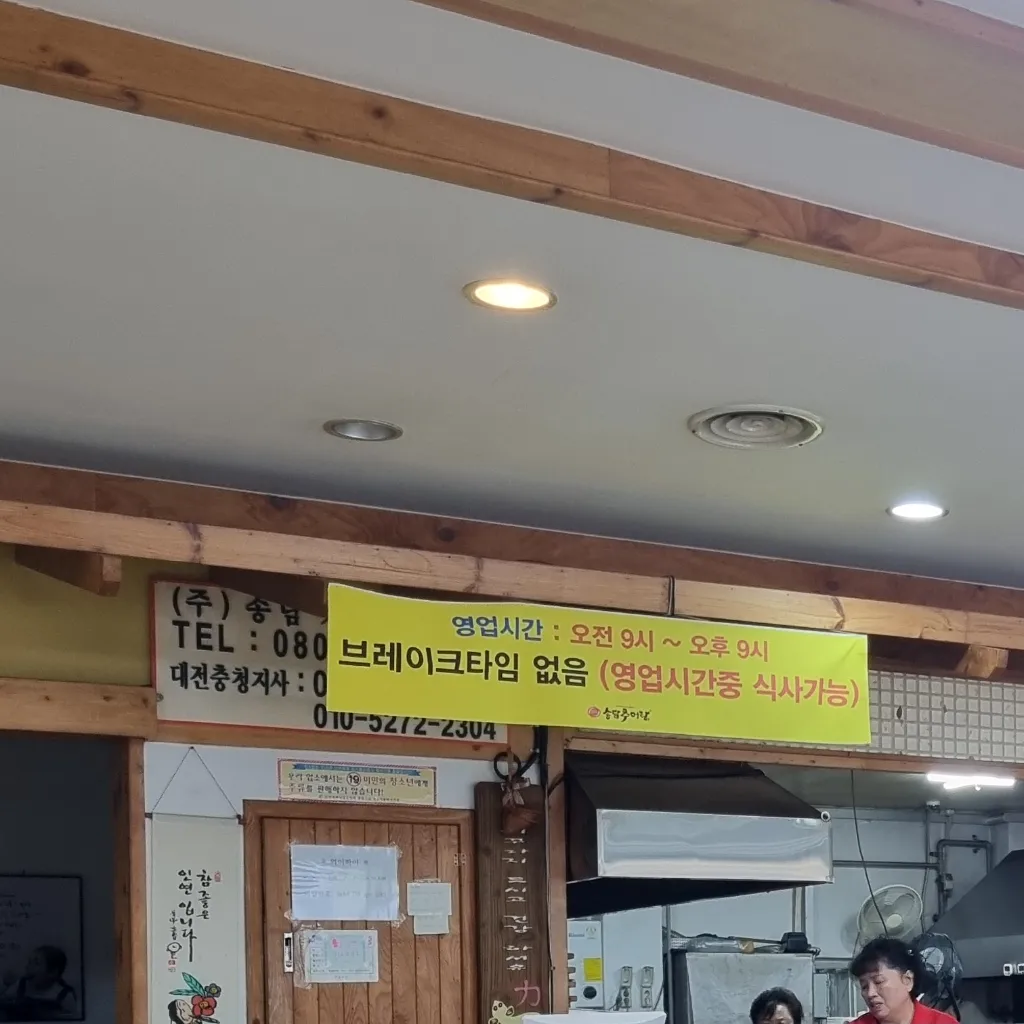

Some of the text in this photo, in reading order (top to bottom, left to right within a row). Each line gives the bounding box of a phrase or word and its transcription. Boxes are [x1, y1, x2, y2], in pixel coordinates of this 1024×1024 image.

[172, 585, 230, 622] (주)
[172, 620, 235, 654] TEL
[451, 615, 544, 641] 영업시간
[569, 622, 614, 650] 오전
[621, 629, 655, 653] 9시
[688, 634, 731, 659] 오후
[736, 638, 770, 662] 9시
[170, 662, 290, 697] 대전충청지사
[338, 637, 861, 709] 브레이크타임 없음 (영업시간중 식사가능)
[178, 869, 193, 895] 인연
[197, 870, 212, 887] 참
